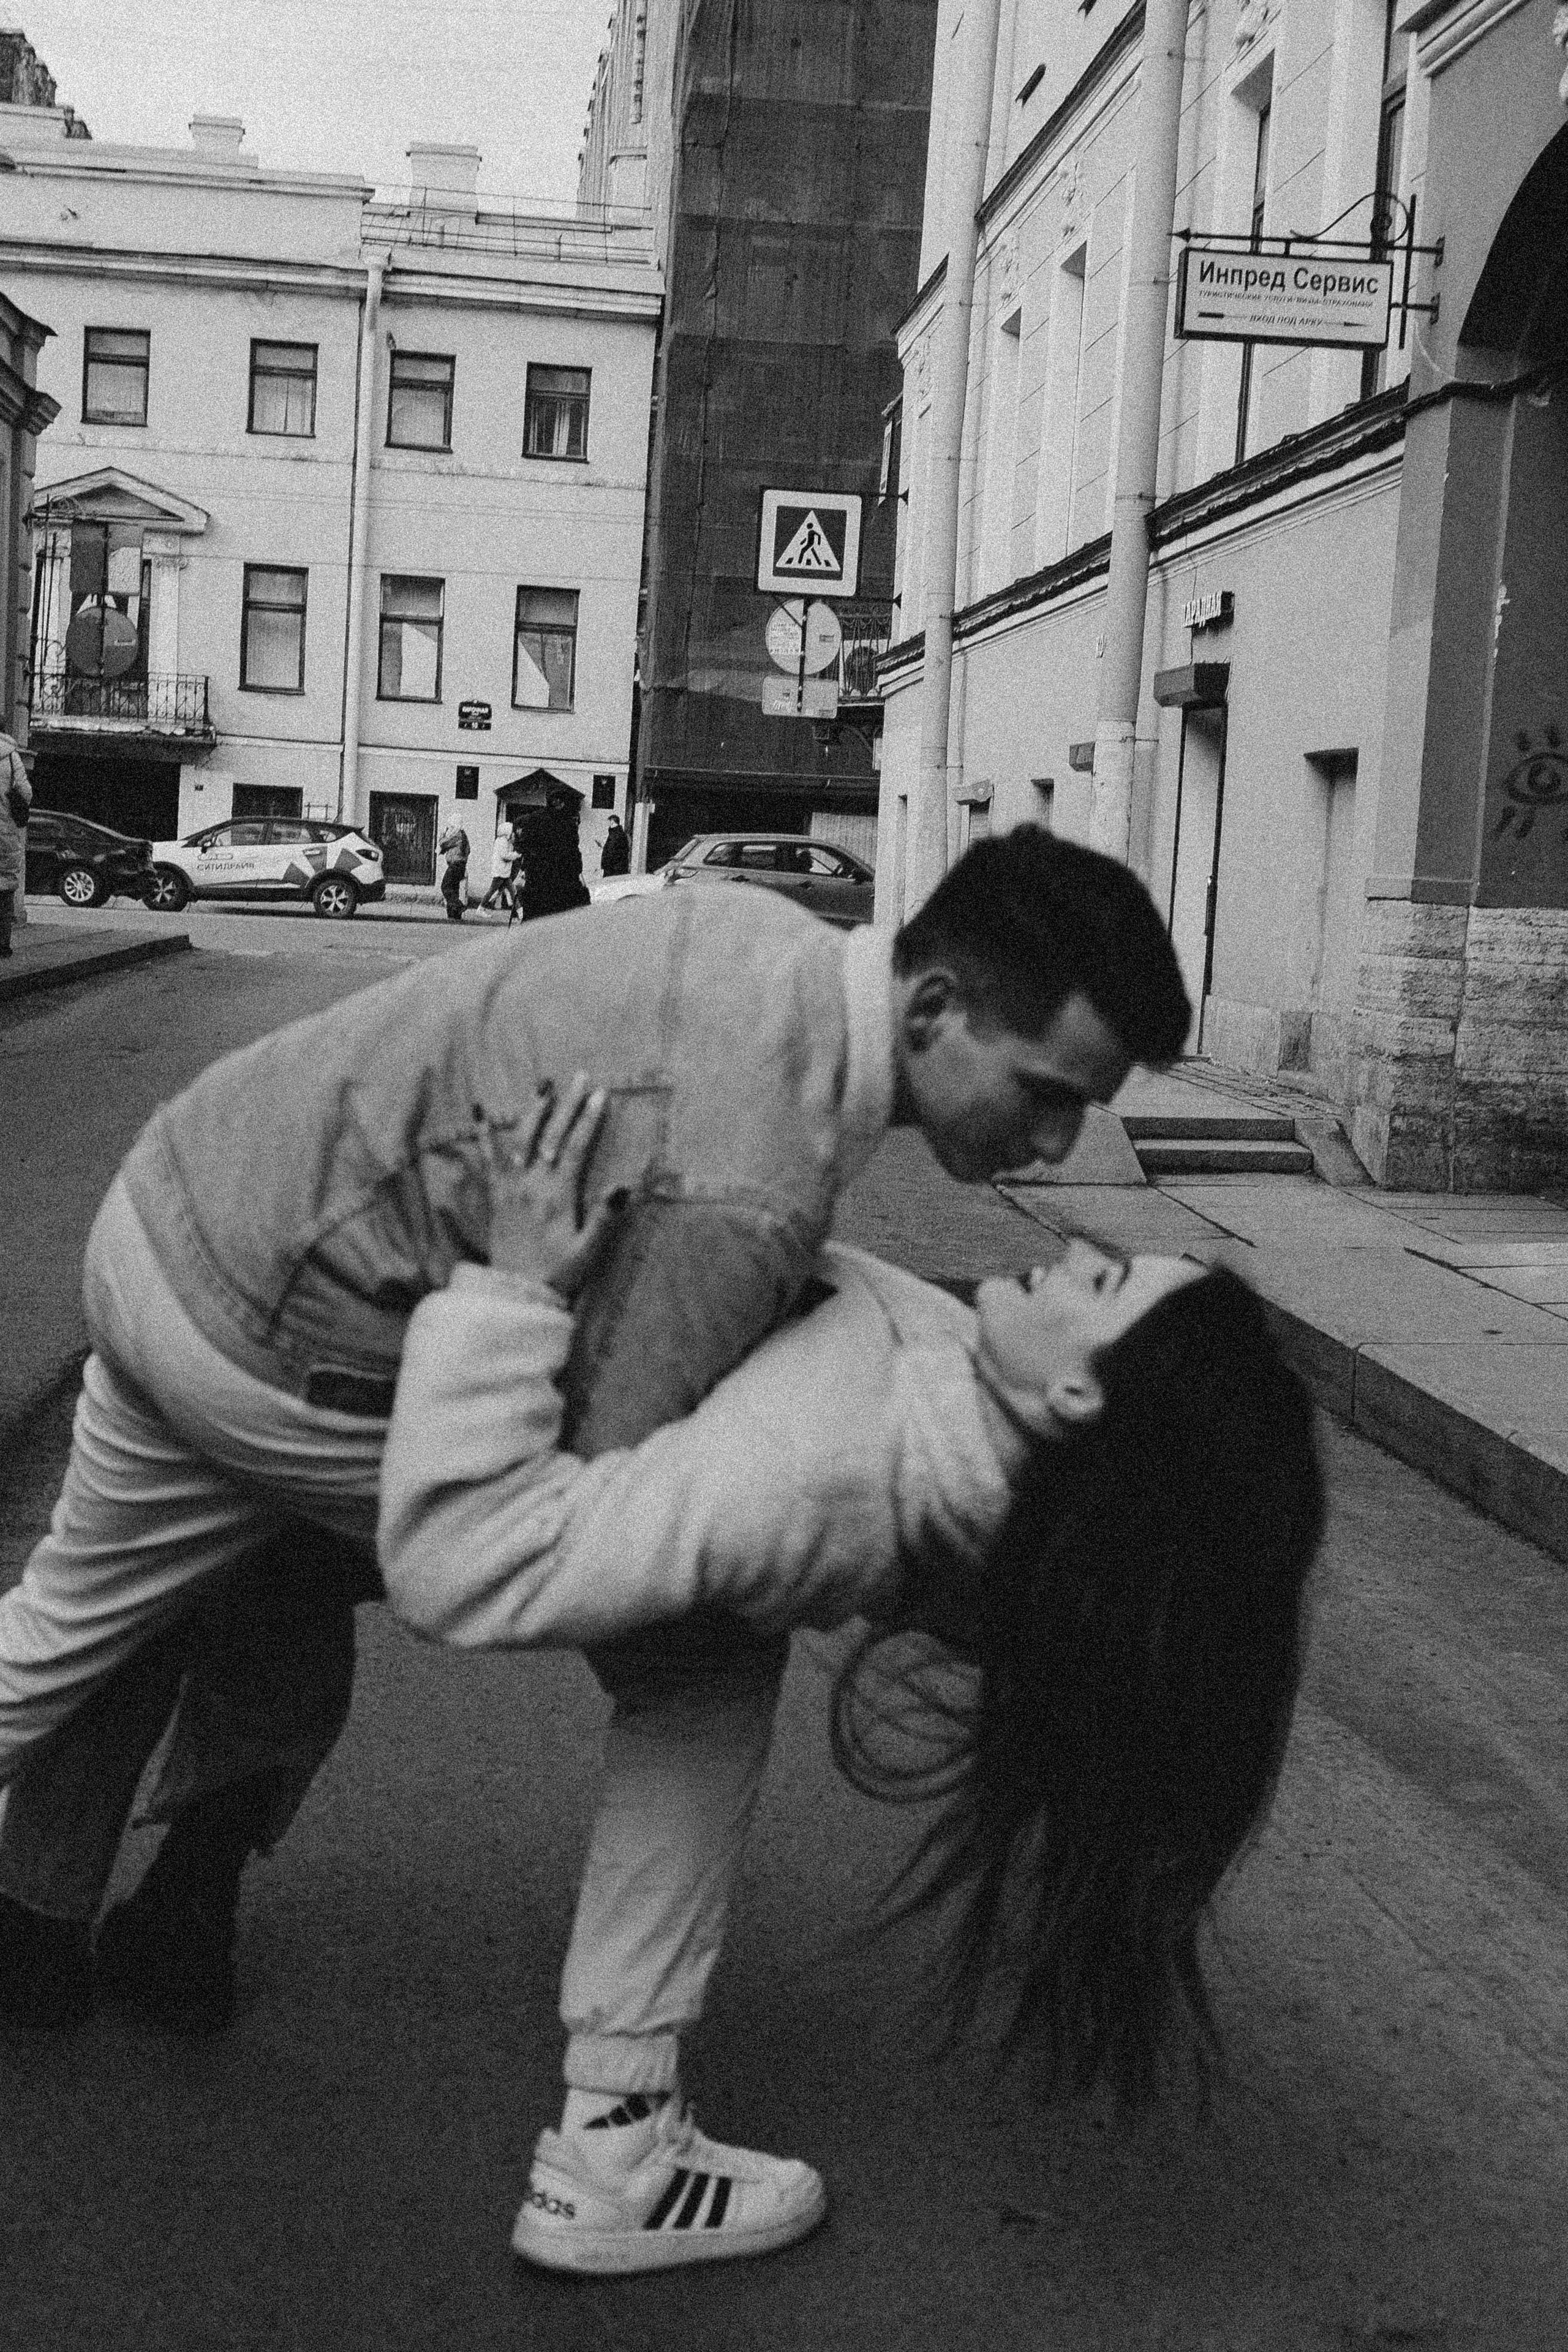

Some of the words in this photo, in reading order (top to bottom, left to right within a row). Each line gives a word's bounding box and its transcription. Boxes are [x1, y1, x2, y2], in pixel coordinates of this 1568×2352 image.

[1199, 260, 1286, 291] Инпред
[1293, 267, 1379, 296] Сервис
[1250, 314, 1275, 324] ВХОД
[1276, 316, 1297, 326] ПОД
[1298, 317, 1323, 326] АРКУ
